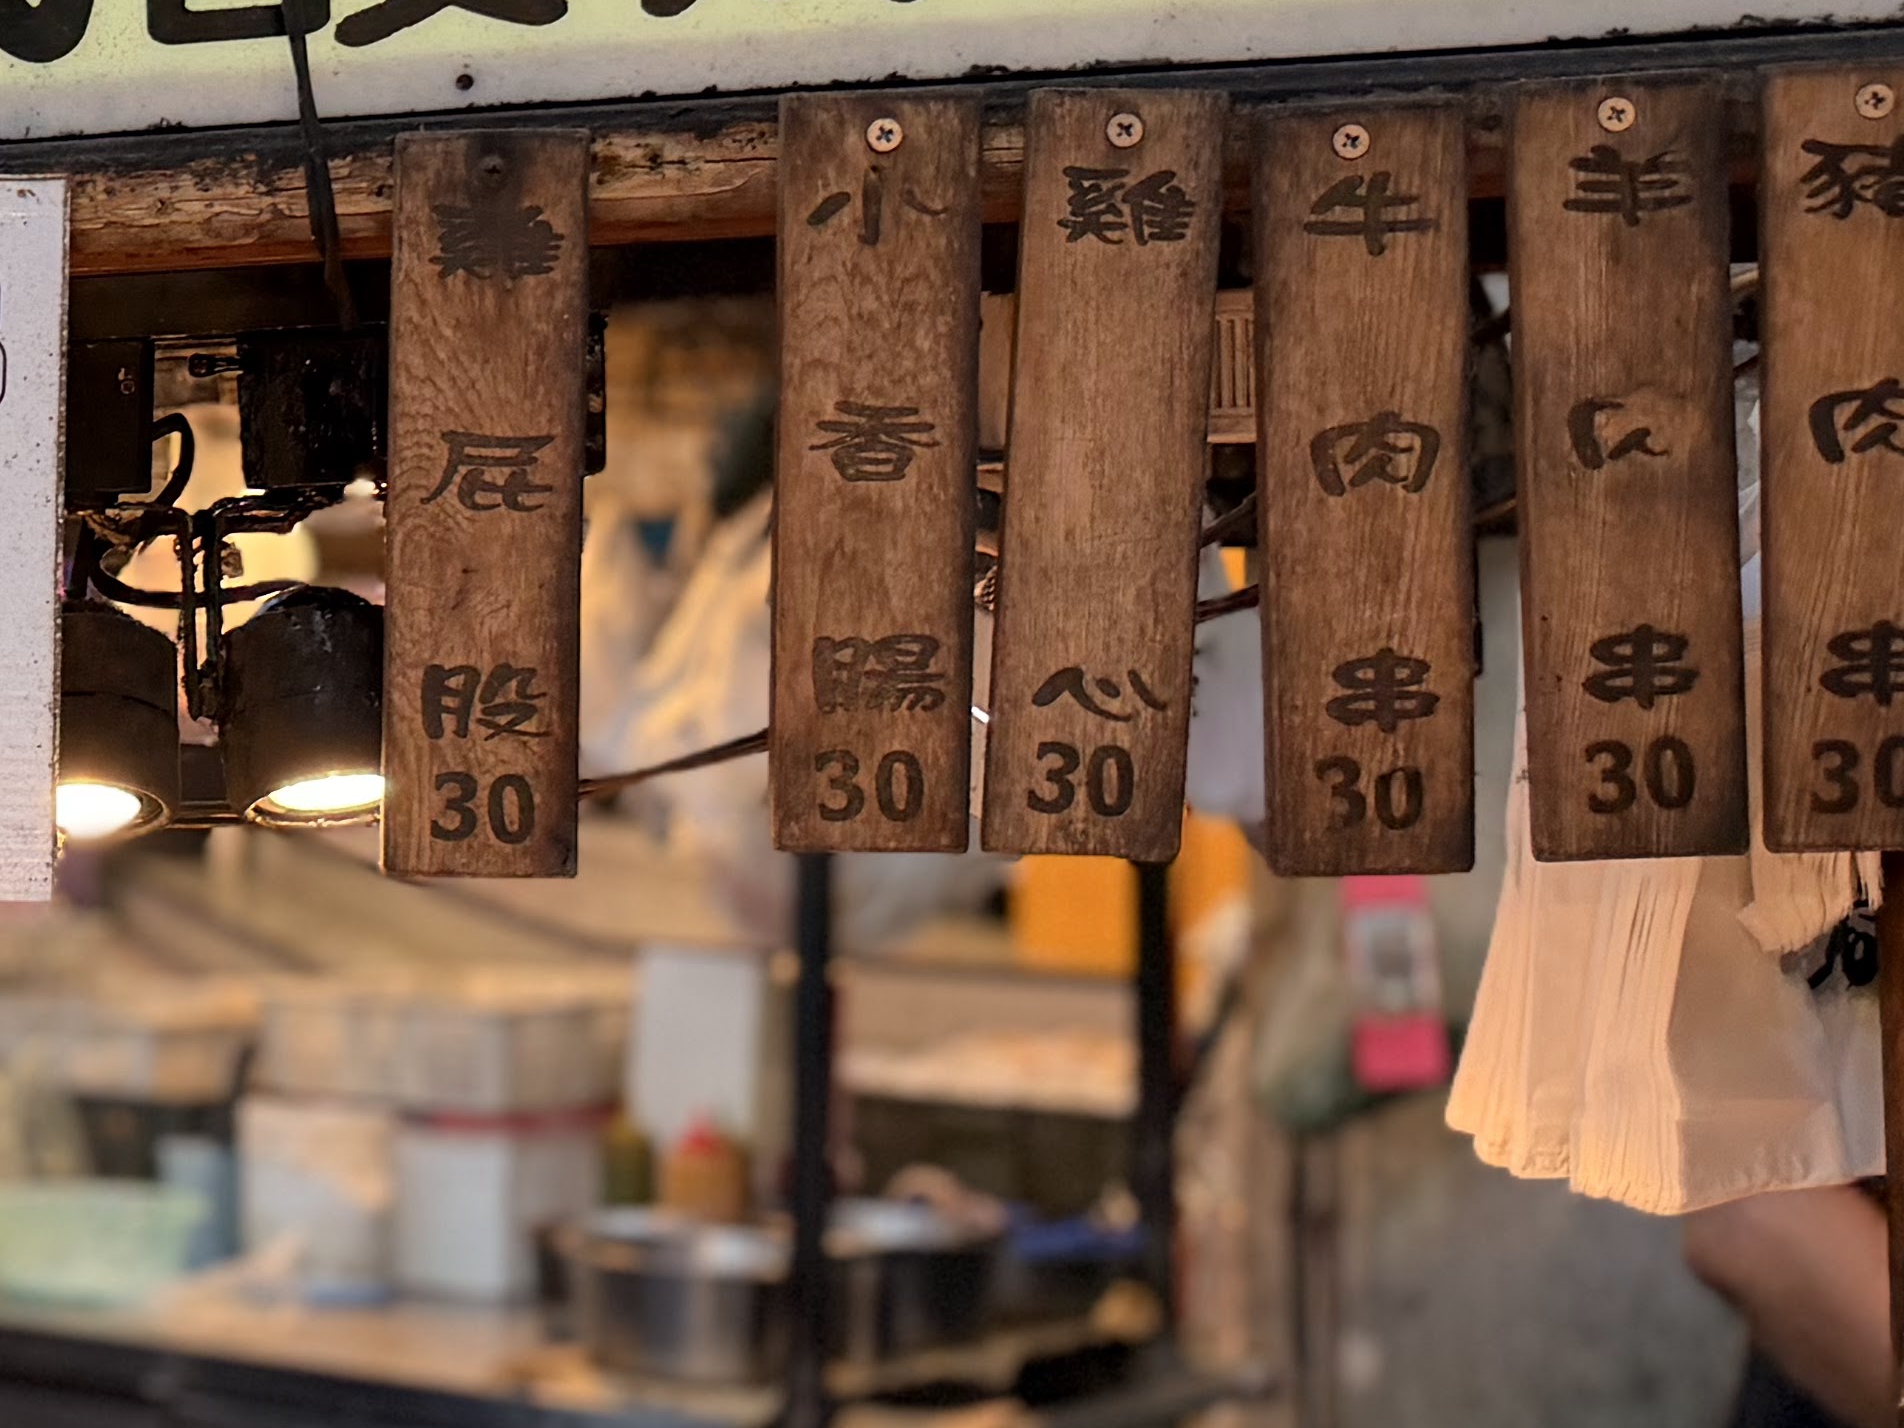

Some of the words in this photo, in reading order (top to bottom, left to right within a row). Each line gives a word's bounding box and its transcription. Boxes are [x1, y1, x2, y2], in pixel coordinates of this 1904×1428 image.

[419, 200, 566, 742] 雞屁股
[1030, 165, 1196, 722] 雞心
[1304, 172, 1440, 734] 牛肉串
[430, 770, 538, 846] 30
[818, 746, 926, 824] 30
[1026, 740, 1136, 818] 30
[1316, 754, 1426, 832] 30
[1584, 734, 1698, 818] 30
